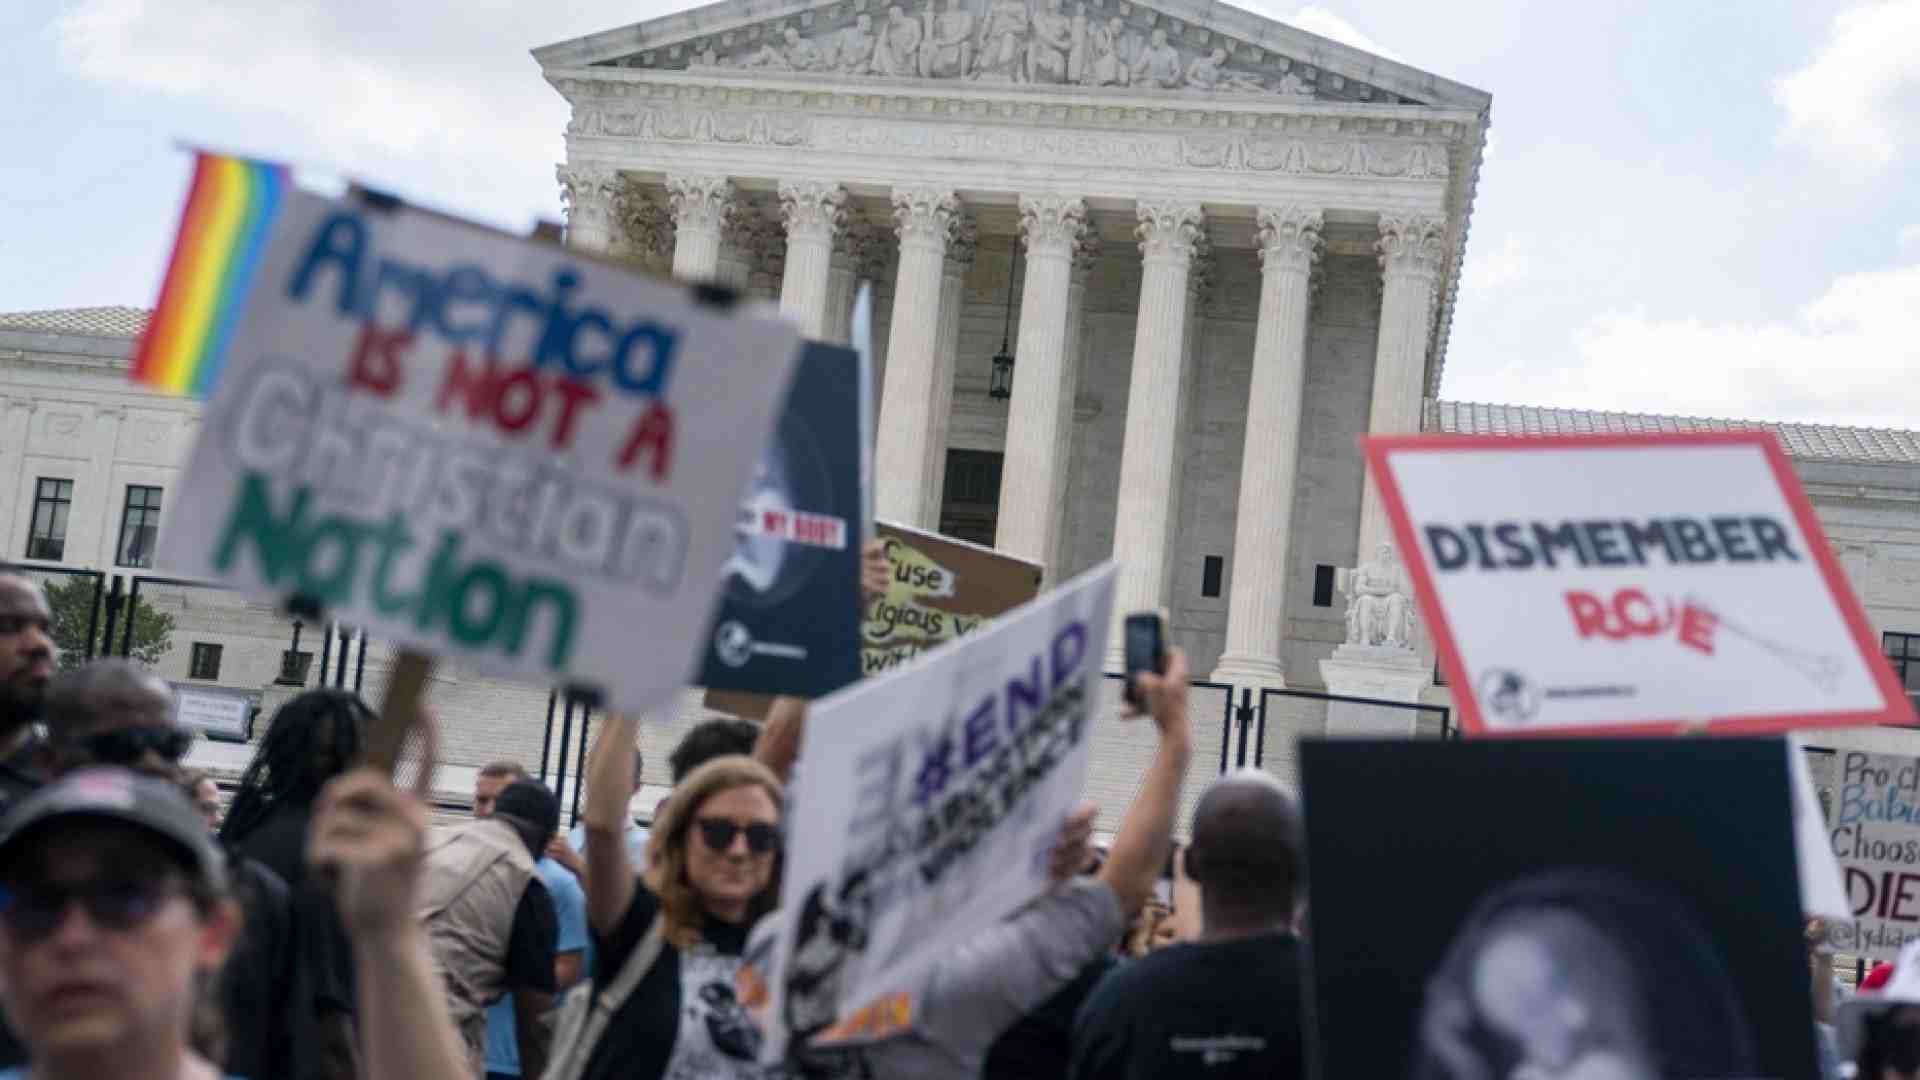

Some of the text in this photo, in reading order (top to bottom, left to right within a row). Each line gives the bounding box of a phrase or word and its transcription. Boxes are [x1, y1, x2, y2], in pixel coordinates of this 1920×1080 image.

[286, 207, 684, 400] America
[222, 354, 694, 596] Christian
[345, 318, 676, 484] IS NOT A
[209, 469, 586, 676] Nation
[1423, 515, 1804, 573] DISMEMBER
[1843, 751, 1889, 787] Pro
